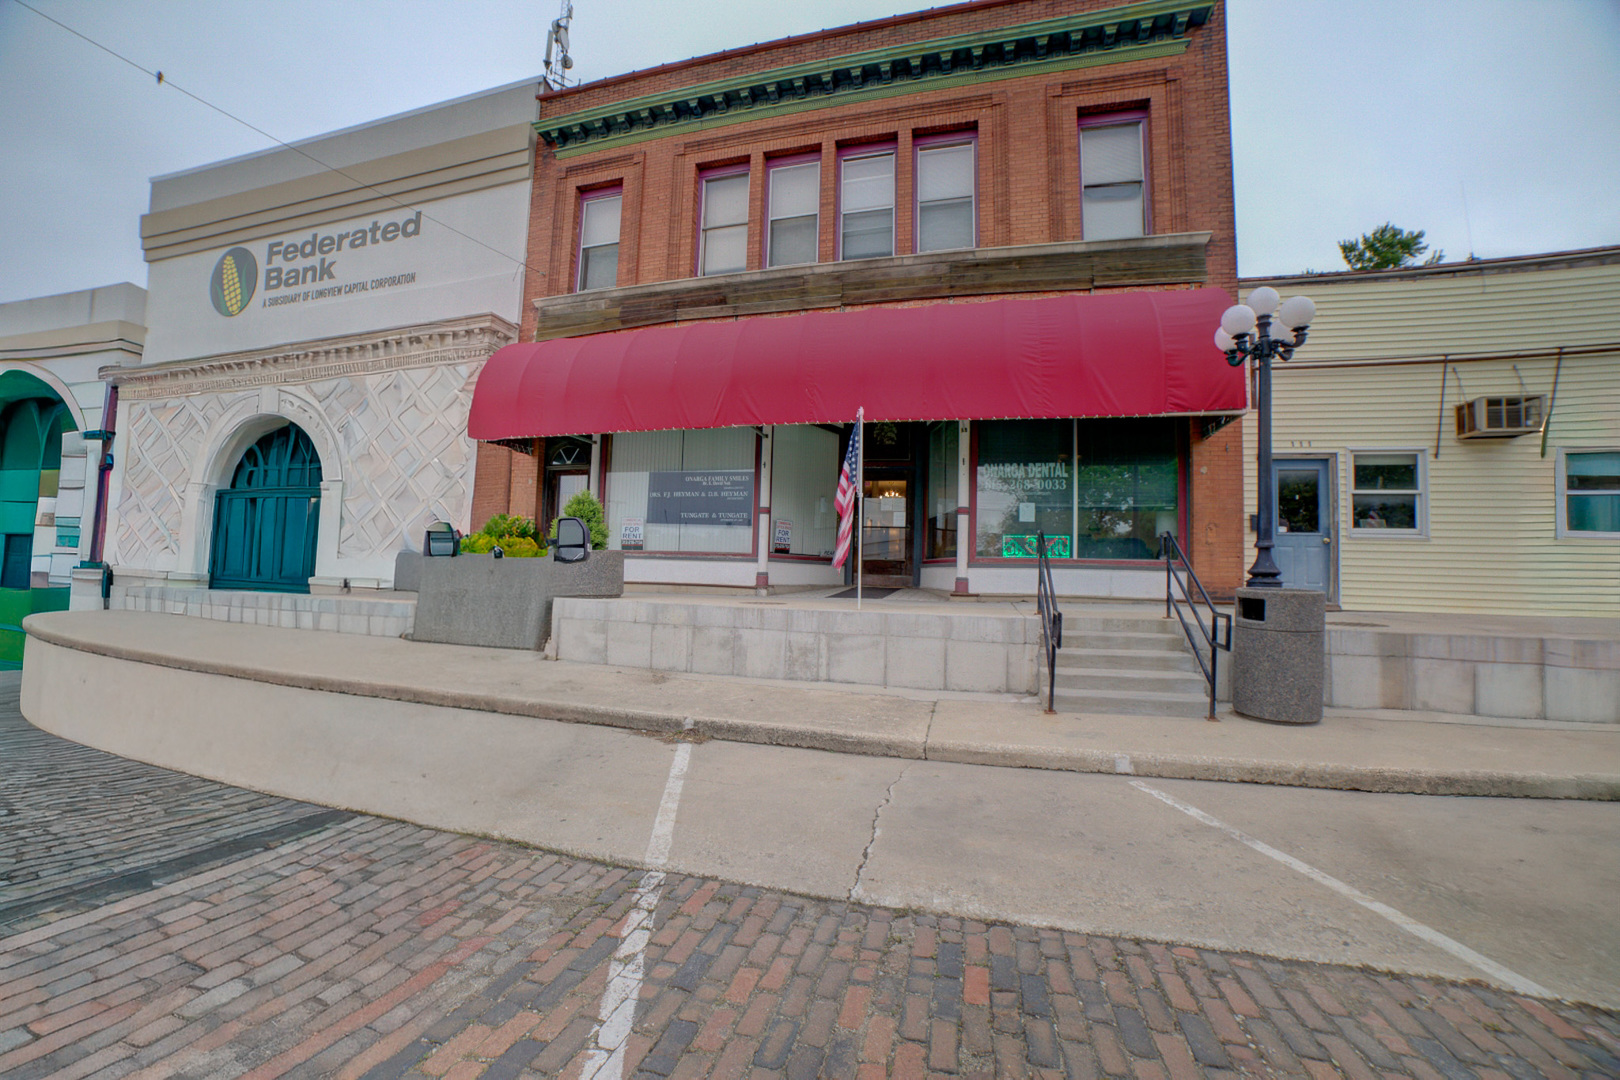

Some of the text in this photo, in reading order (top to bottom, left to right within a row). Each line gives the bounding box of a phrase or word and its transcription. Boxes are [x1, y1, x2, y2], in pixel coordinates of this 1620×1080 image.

[266, 210, 422, 265] Federated
[264, 257, 337, 290] Bank
[262, 272, 416, 309] A SUBSIDIARY OF LONGVIEW CAPITAL CORPORATION
[983, 462, 1069, 478] ONARGA DENTAL
[777, 529, 790, 537] FOR
